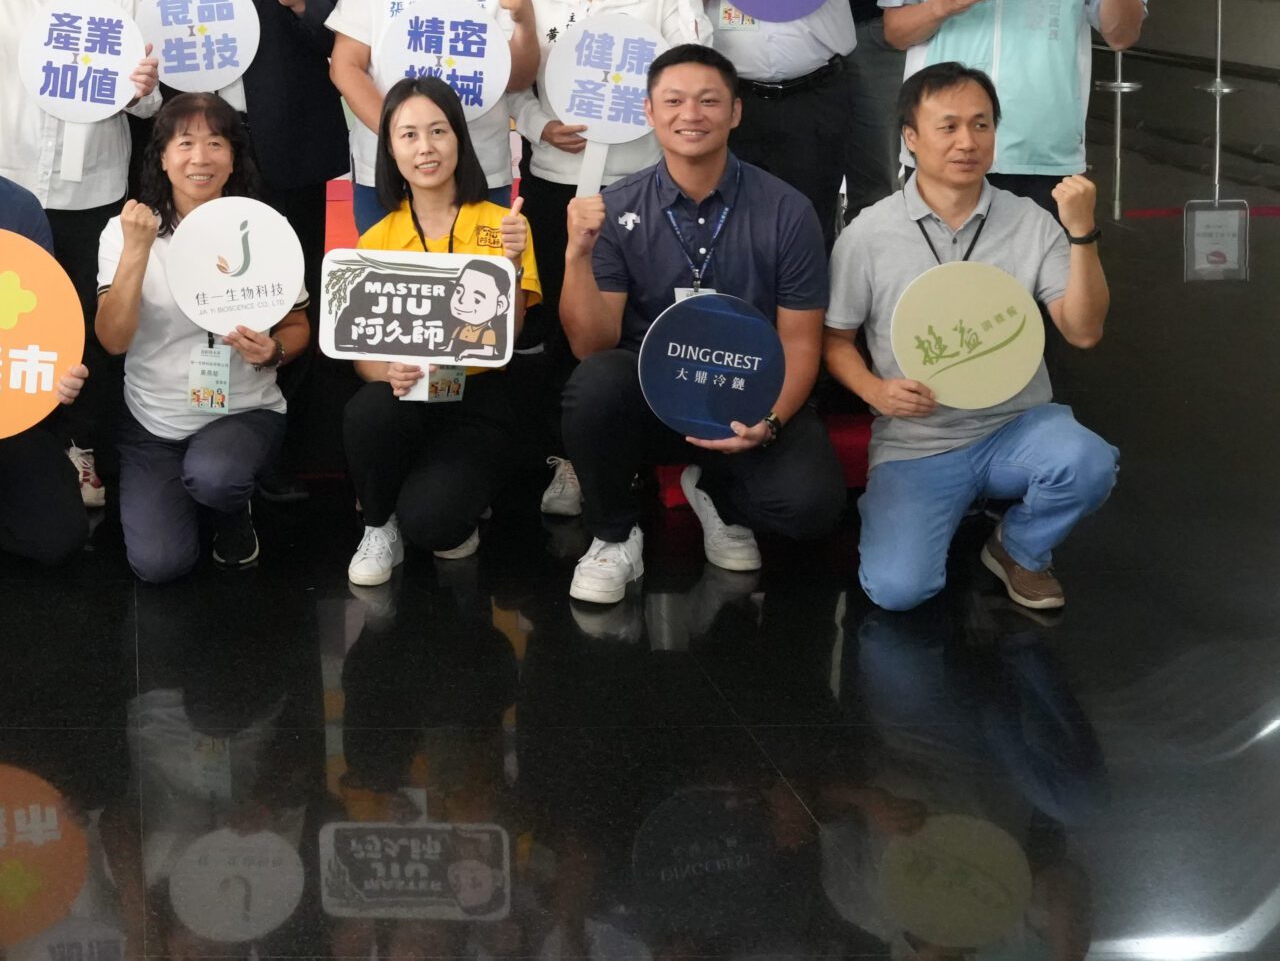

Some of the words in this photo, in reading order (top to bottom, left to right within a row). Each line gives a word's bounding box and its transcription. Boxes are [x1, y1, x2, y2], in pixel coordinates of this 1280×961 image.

[44, 12, 124, 56] 產業
[406, 15, 488, 59] 精密
[161, 32, 239, 75] 生技
[575, 29, 657, 76] 健康
[565, 78, 648, 127] 產業
[195, 282, 284, 306] 佳一生物科技
[364, 281, 445, 297] MASTER
[371, 296, 432, 315] JIU
[351, 317, 445, 351] 阿久師
[667, 342, 762, 371] DINGCREST
[674, 368, 745, 391] 大鼎冷鏈
